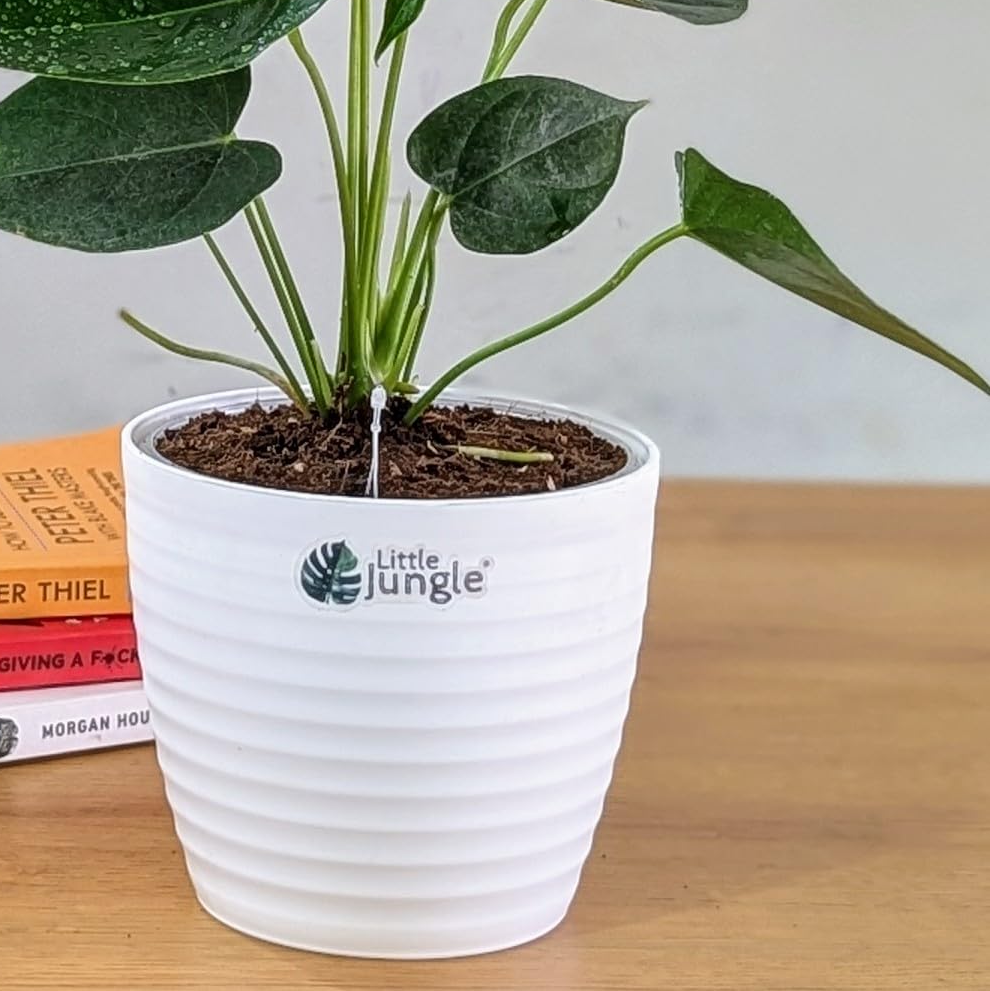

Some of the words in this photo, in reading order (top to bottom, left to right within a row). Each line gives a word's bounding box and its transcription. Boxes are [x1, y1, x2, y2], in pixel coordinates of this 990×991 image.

[1, 467, 58, 503] THIEL
[31, 505, 95, 545] PETER
[377, 549, 440, 571] Little
[38, 579, 111, 602] THIEL
[70, 651, 84, 669] A
[90, 647, 138, 669] FCK
[42, 716, 111, 739] MORGAN
[117, 710, 151, 728] HOU
